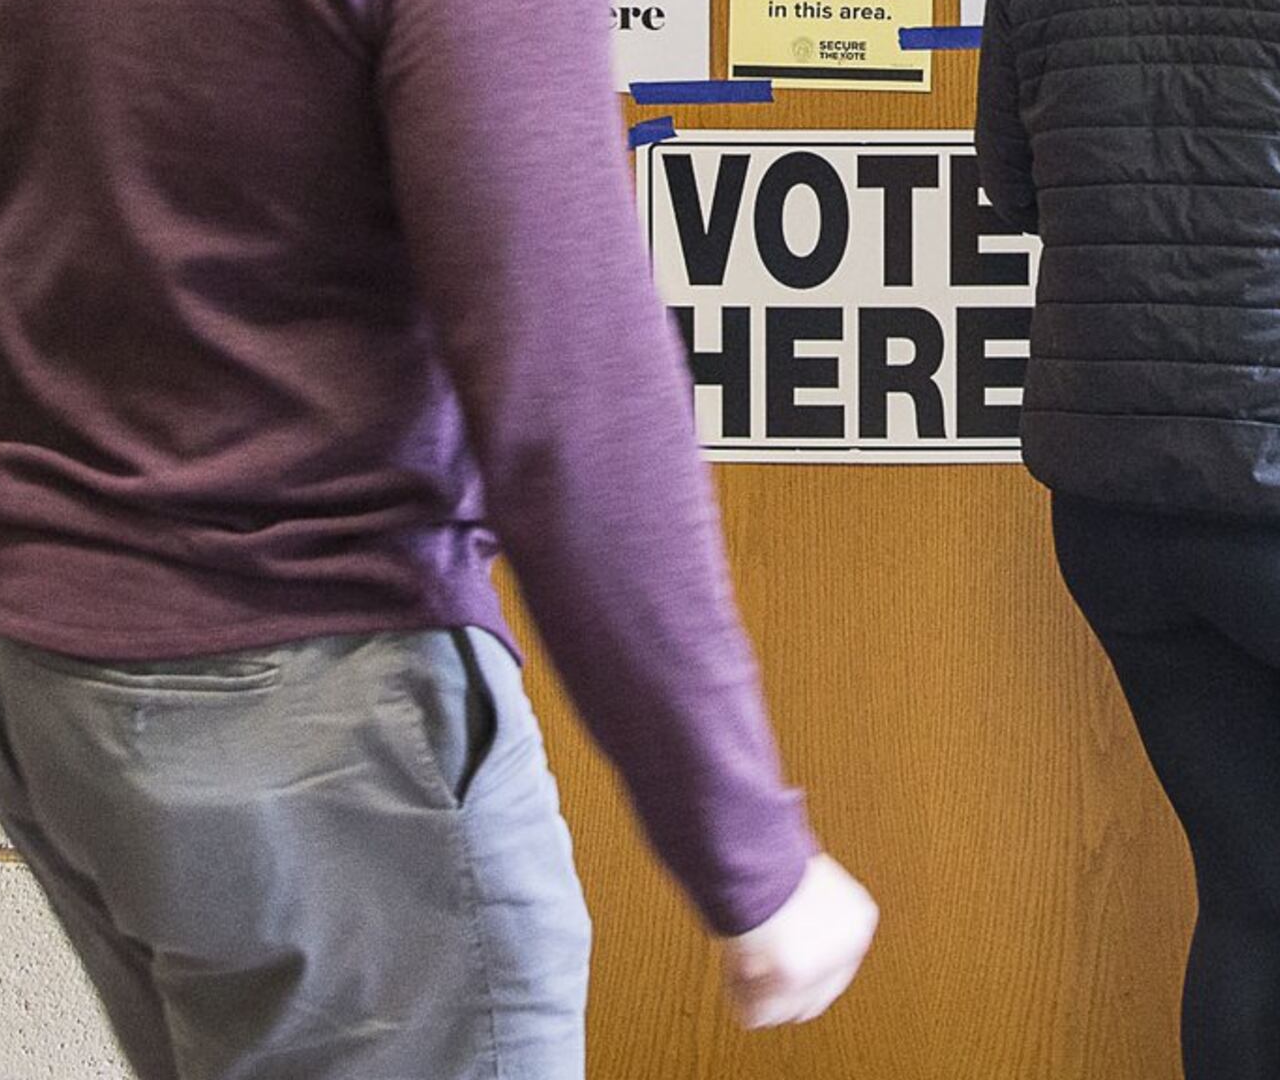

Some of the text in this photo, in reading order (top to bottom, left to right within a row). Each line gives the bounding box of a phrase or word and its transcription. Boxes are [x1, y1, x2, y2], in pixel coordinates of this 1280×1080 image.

[769, 1, 892, 20] in this area.
[819, 41, 866, 51] SECURE
[819, 51, 838, 60] THE
[662, 151, 1031, 290] VOTE
[669, 306, 1031, 439] HERE
